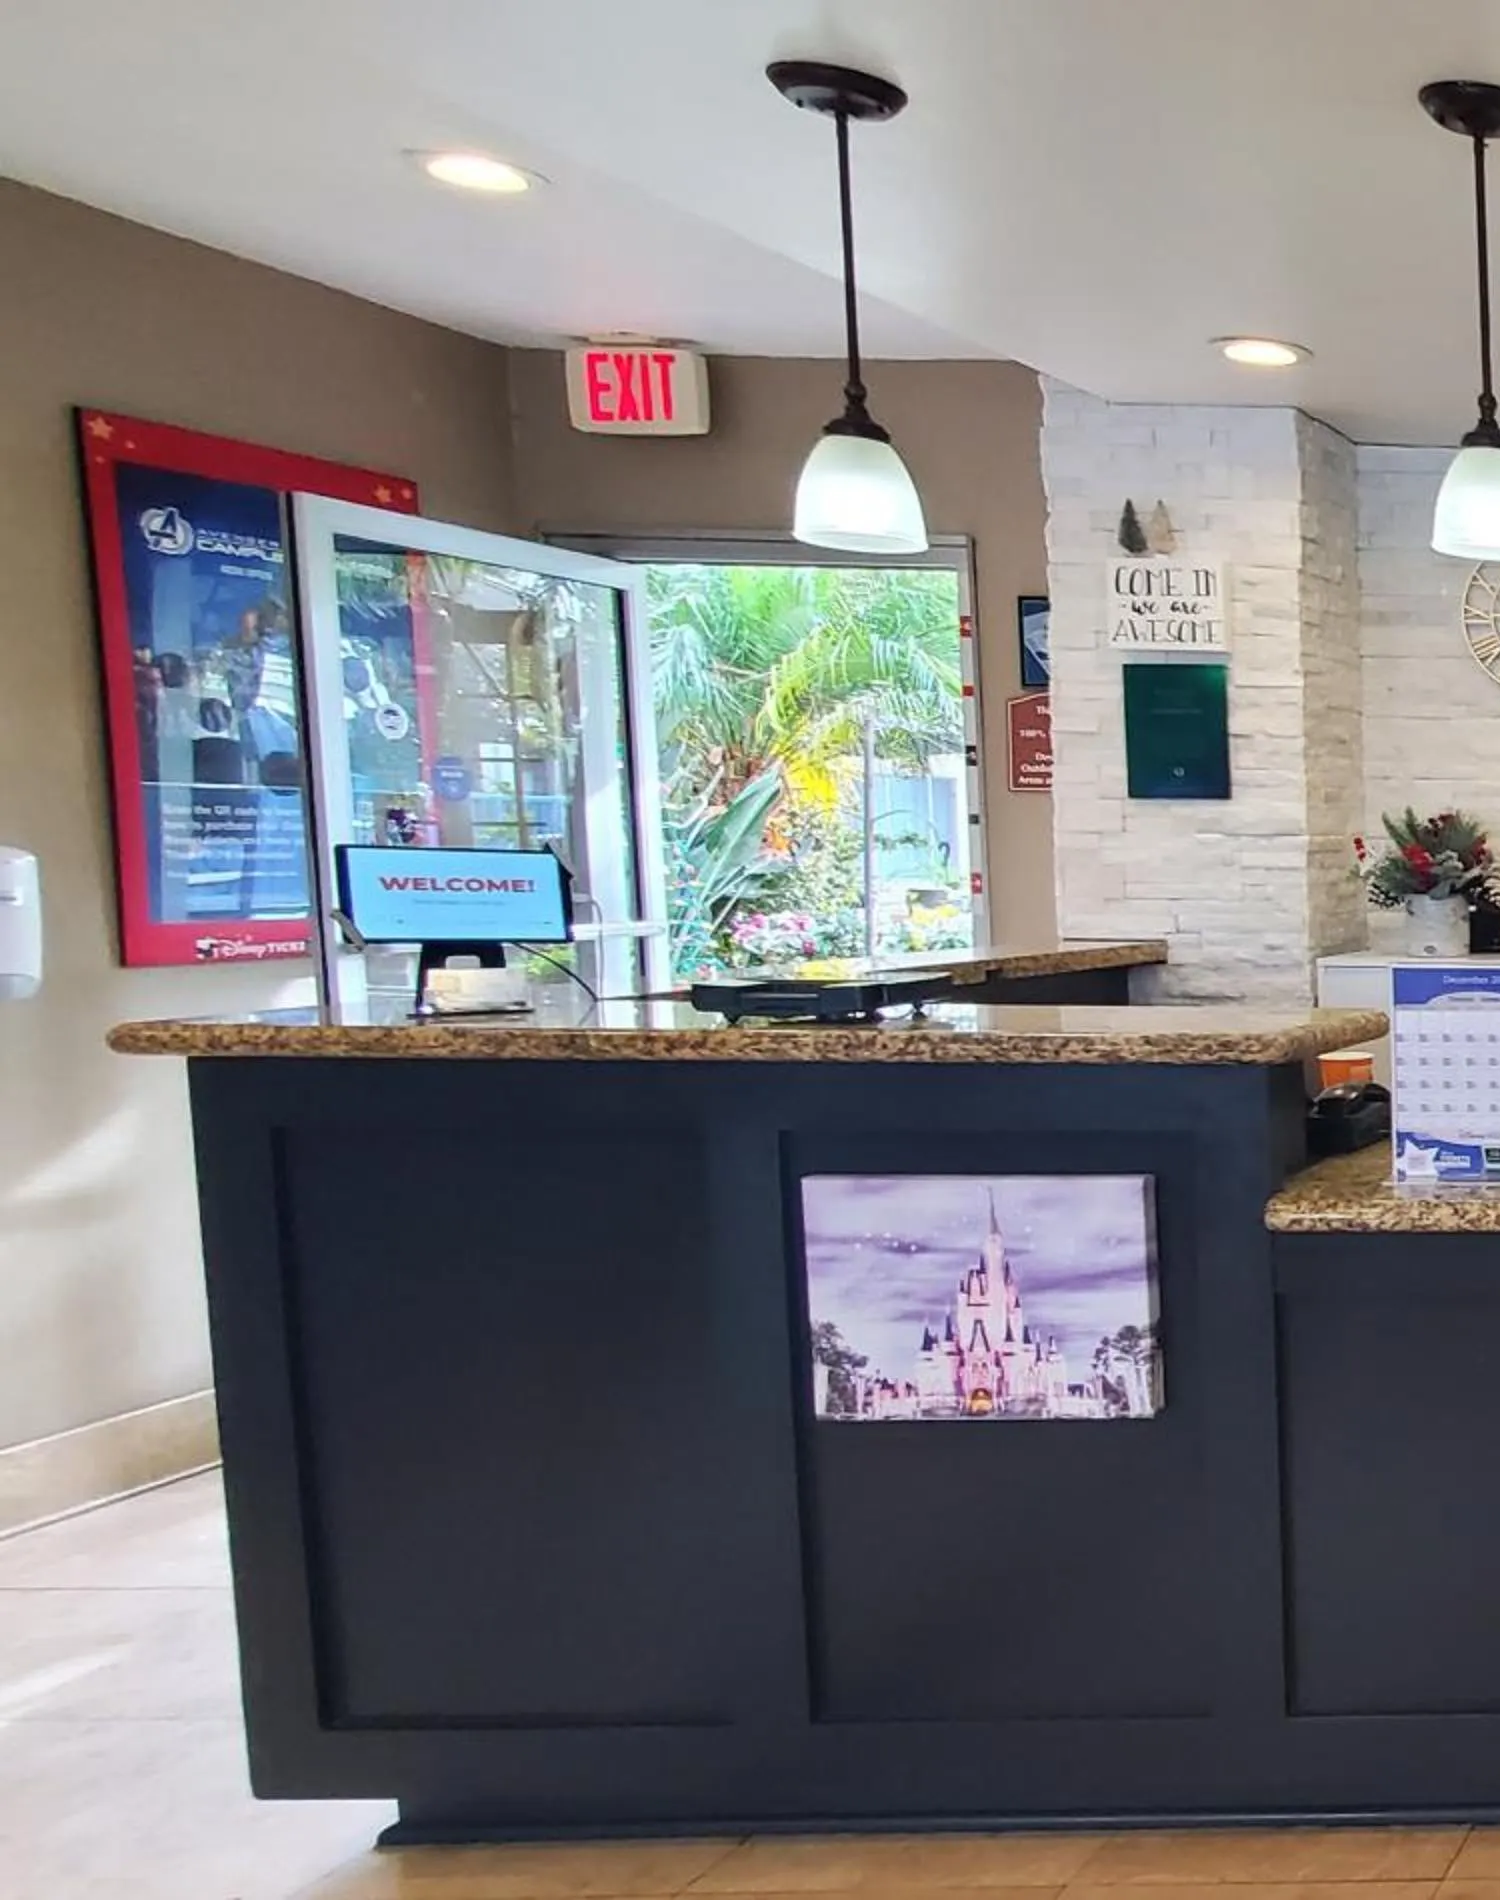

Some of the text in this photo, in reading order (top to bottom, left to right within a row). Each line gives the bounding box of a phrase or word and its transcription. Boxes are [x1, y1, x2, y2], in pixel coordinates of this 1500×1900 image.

[586, 353, 675, 421] EXIT
[1114, 566, 1217, 596] COME IN
[1131, 600, 1201, 616] we are
[1112, 619, 1223, 644] AWESOME
[379, 876, 535, 893] WELCOME!
